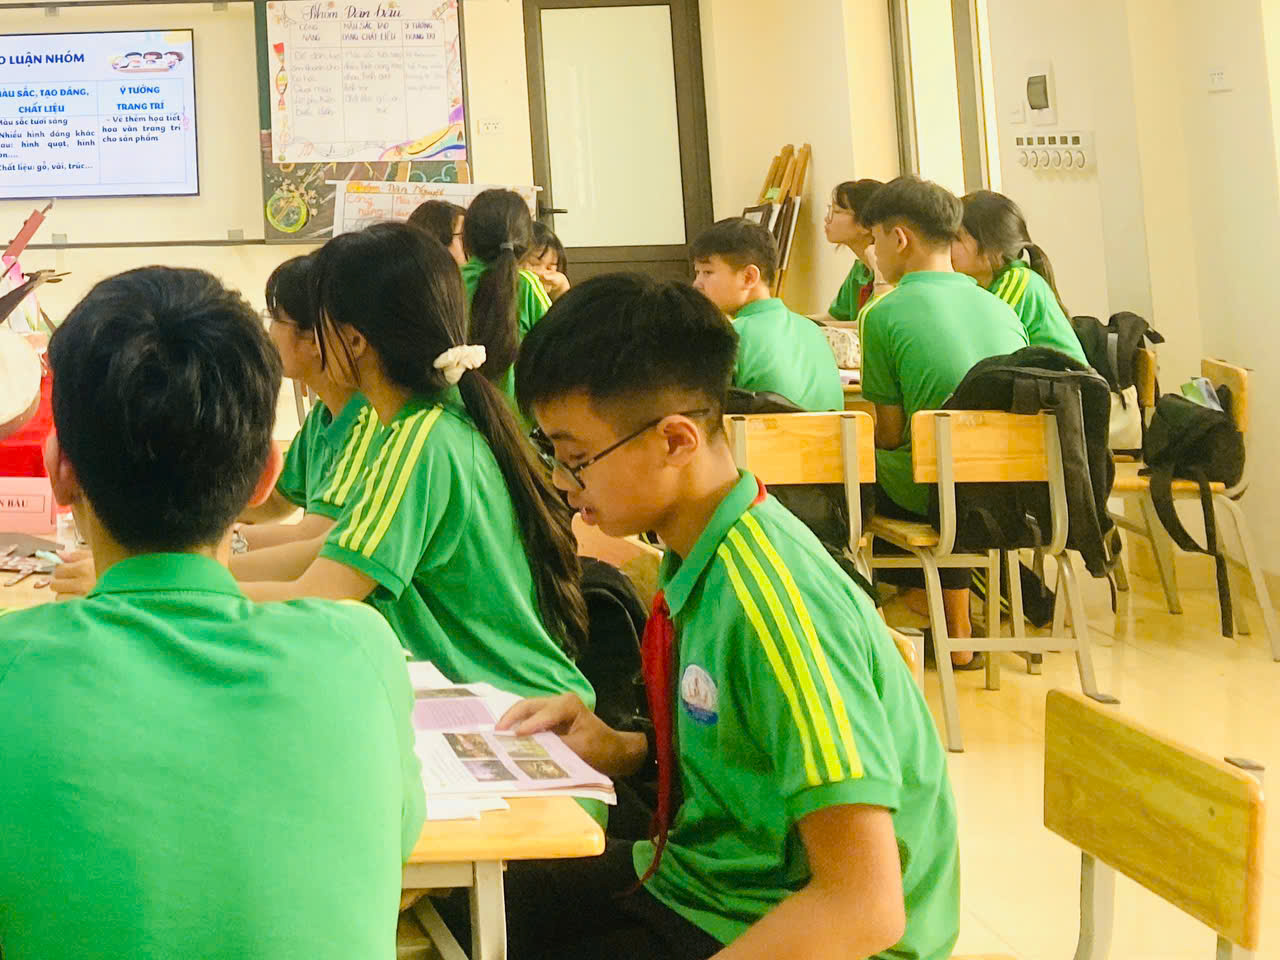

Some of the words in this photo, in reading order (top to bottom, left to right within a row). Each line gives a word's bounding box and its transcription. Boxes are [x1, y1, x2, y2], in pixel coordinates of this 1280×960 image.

[9, 51, 42, 68] LUẬN
[45, 50, 85, 65] NHÓM
[116, 102, 148, 112] TRANG
